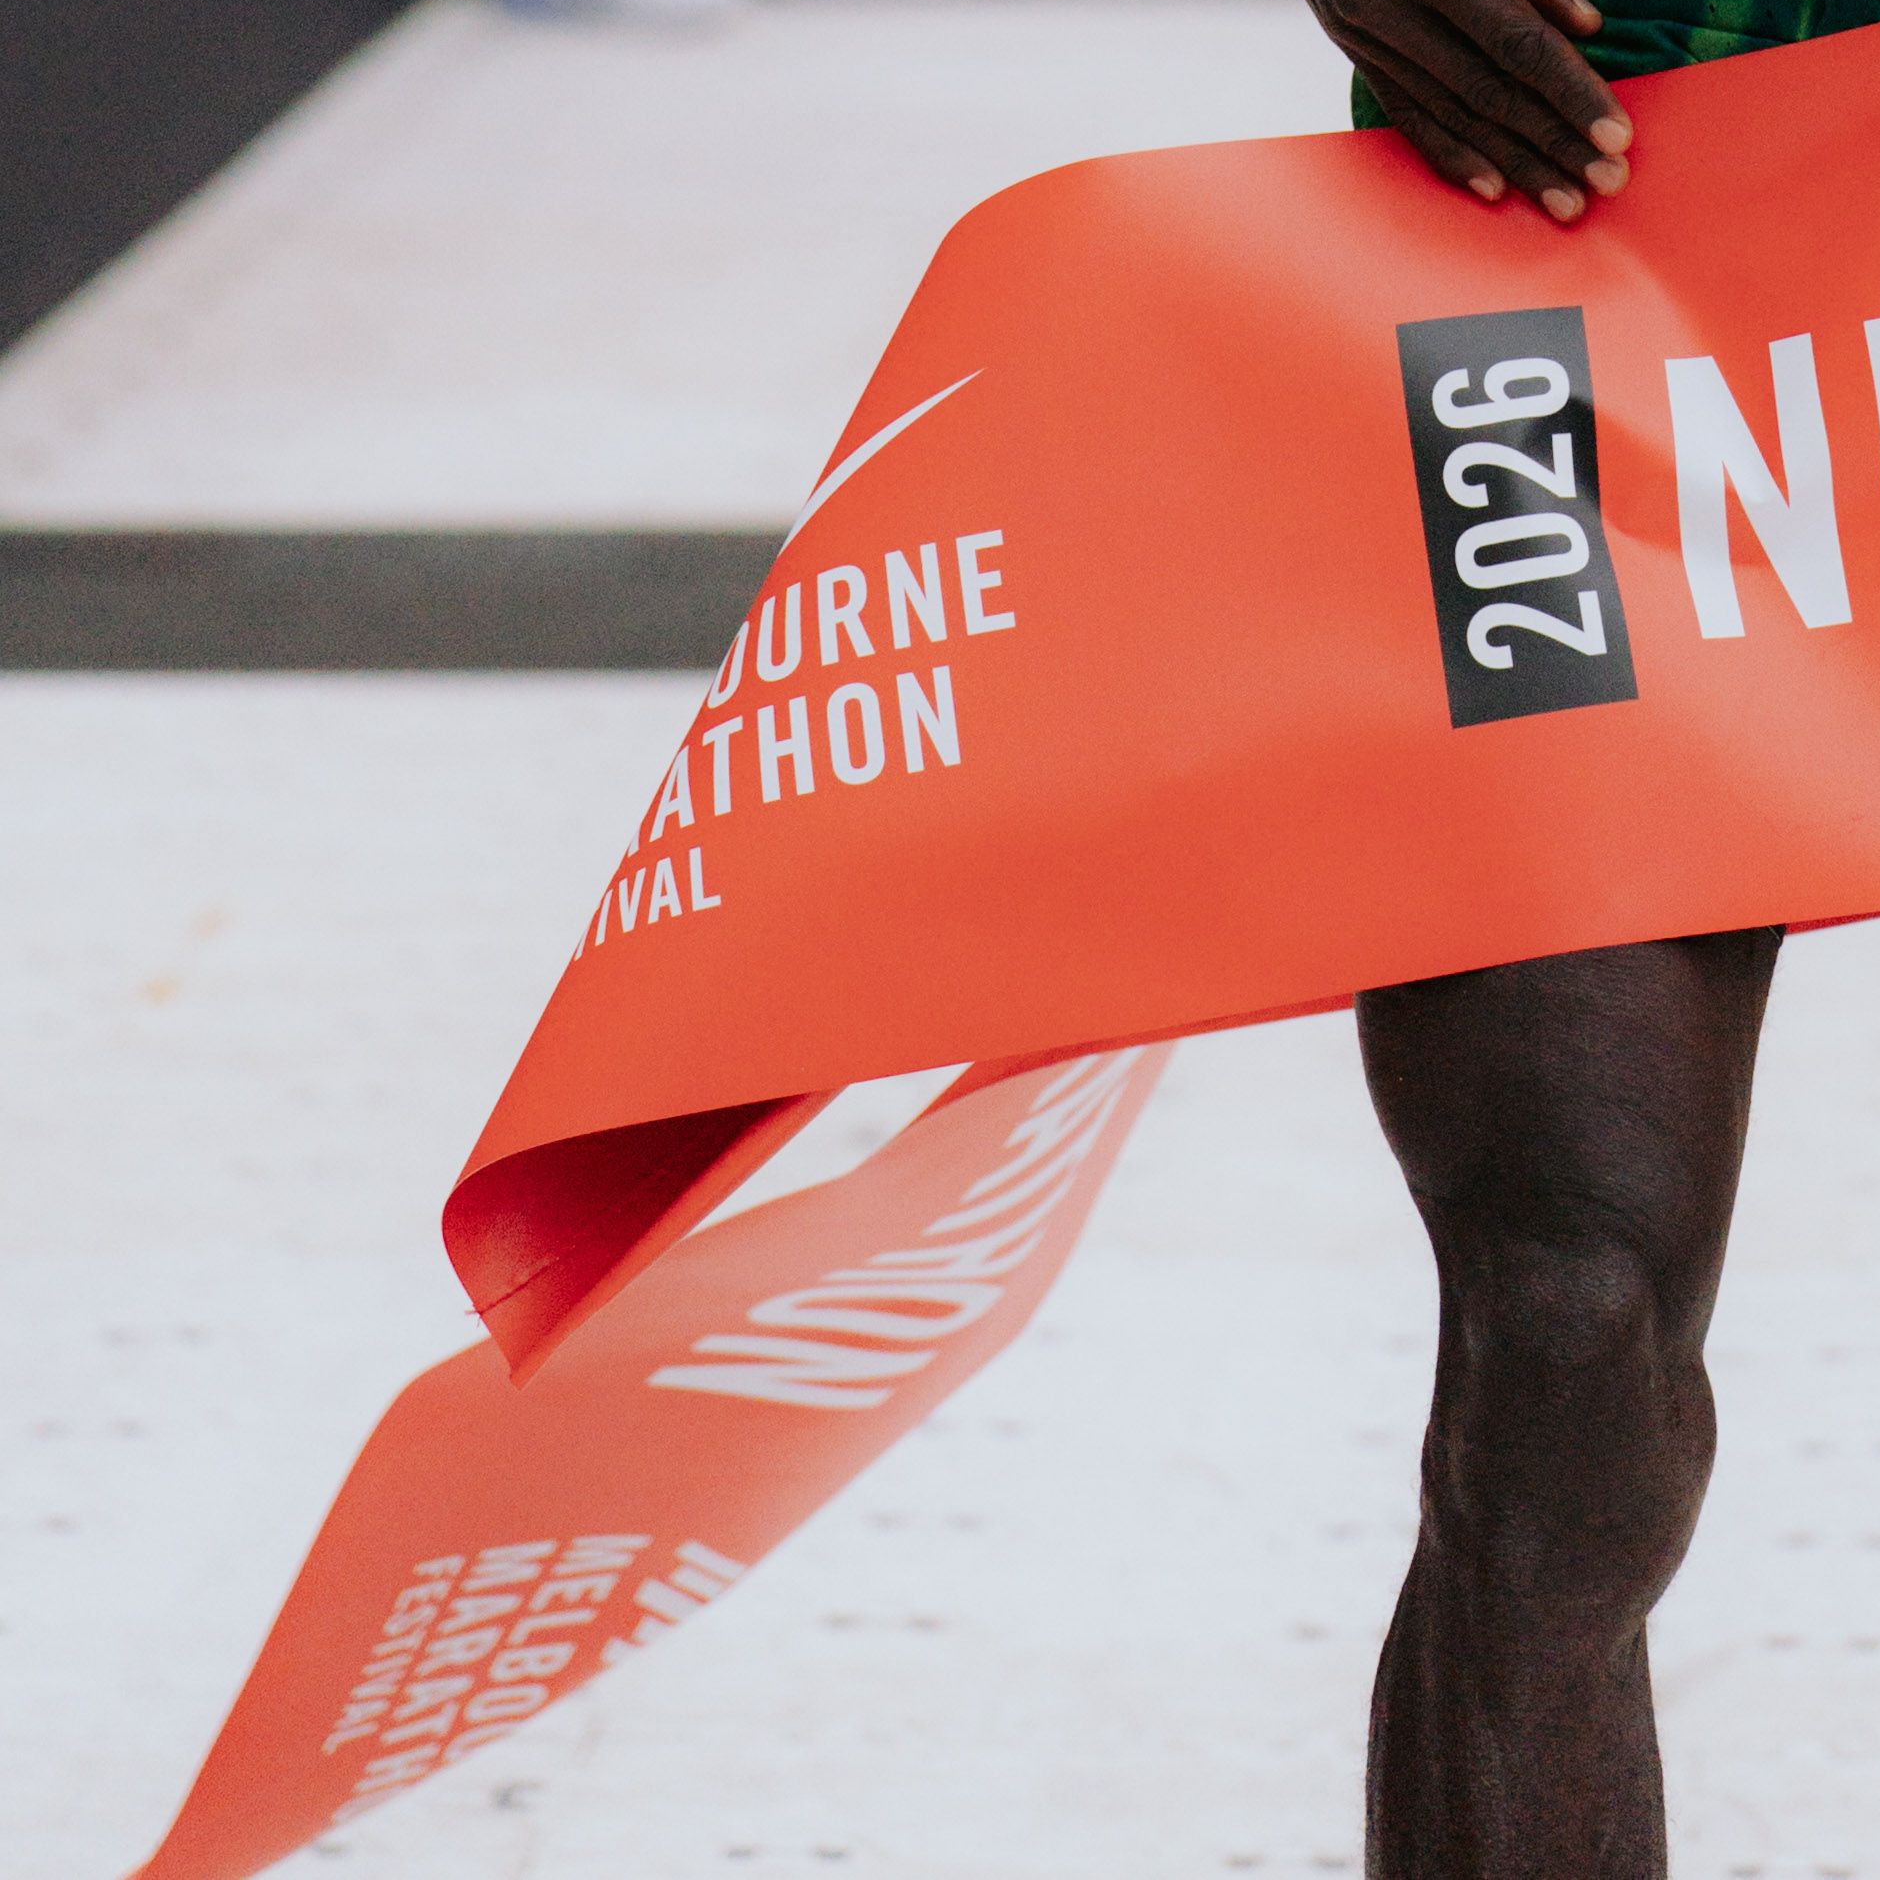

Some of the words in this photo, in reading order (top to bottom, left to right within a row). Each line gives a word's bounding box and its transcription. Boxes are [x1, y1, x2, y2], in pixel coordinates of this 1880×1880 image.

[1432, 356, 1608, 670] 2026
[628, 665, 961, 857] ATHON
[574, 846, 721, 961] IVAL
[321, 1554, 466, 1755] FESTIVAL
[332, 1539, 557, 1825] MARATH
